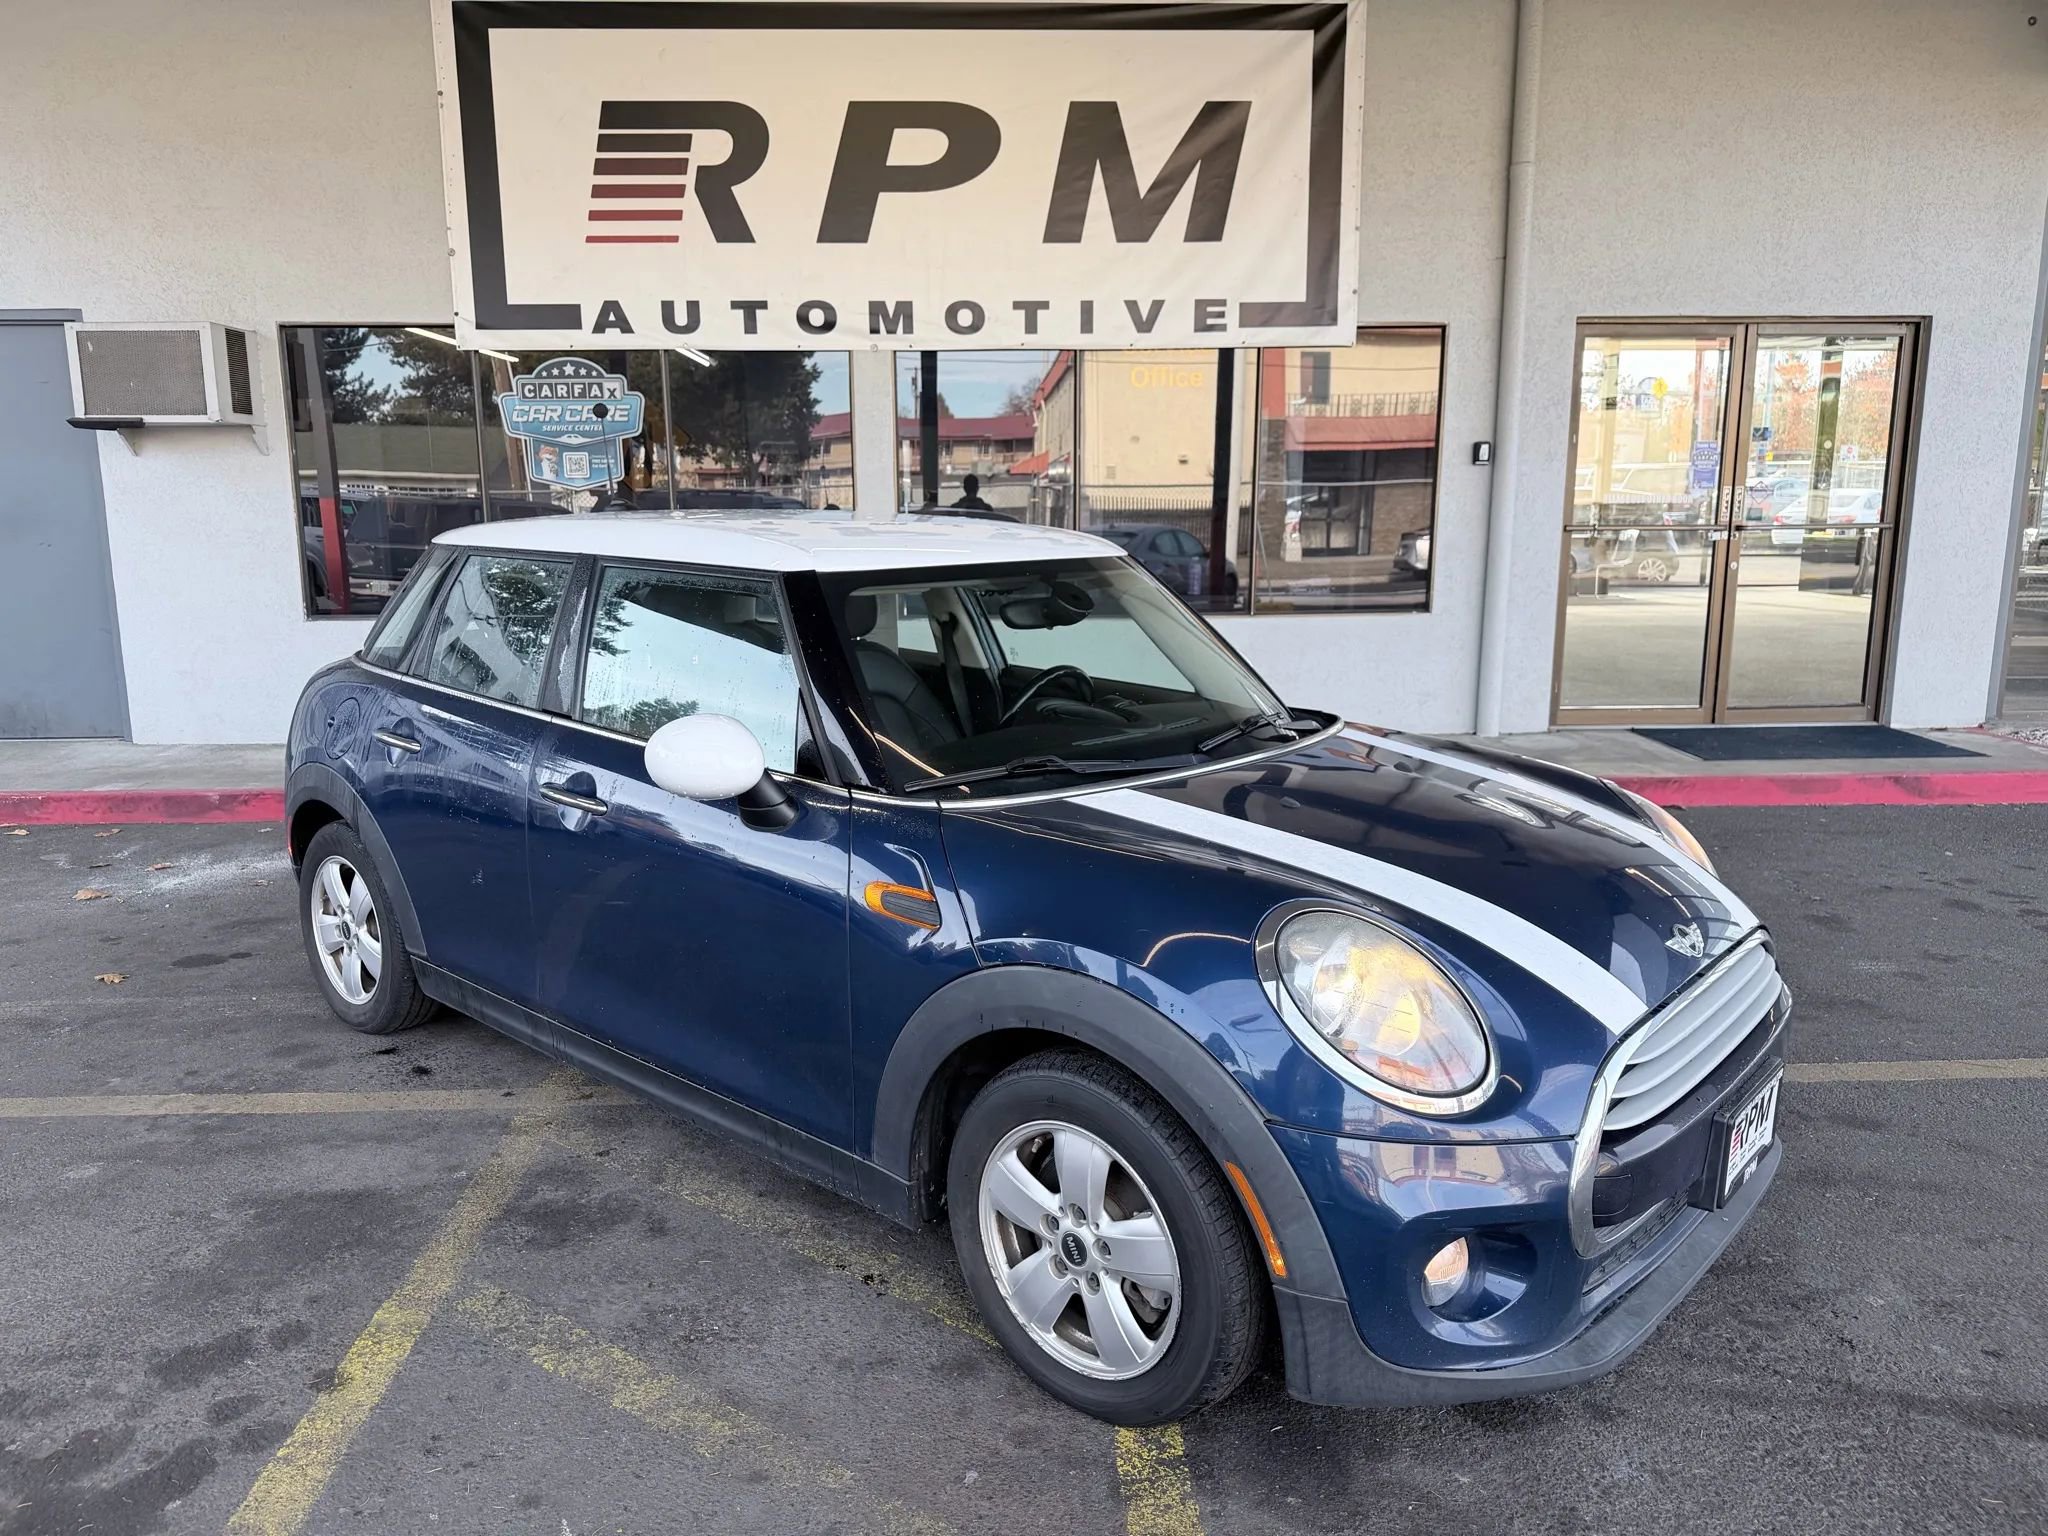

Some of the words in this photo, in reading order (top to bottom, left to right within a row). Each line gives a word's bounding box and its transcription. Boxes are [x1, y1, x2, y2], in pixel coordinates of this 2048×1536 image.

[585, 101, 1253, 243] RPM
[591, 299, 1227, 335] AUTOMOTIVE
[1130, 366, 1204, 388] Office
[522, 383, 619, 399] CARFAX
[512, 404, 562, 422] CAR
[542, 424, 573, 432] SERVICE
[1730, 1087, 1774, 1163] RPM
[1066, 1236, 1082, 1263] MINI
